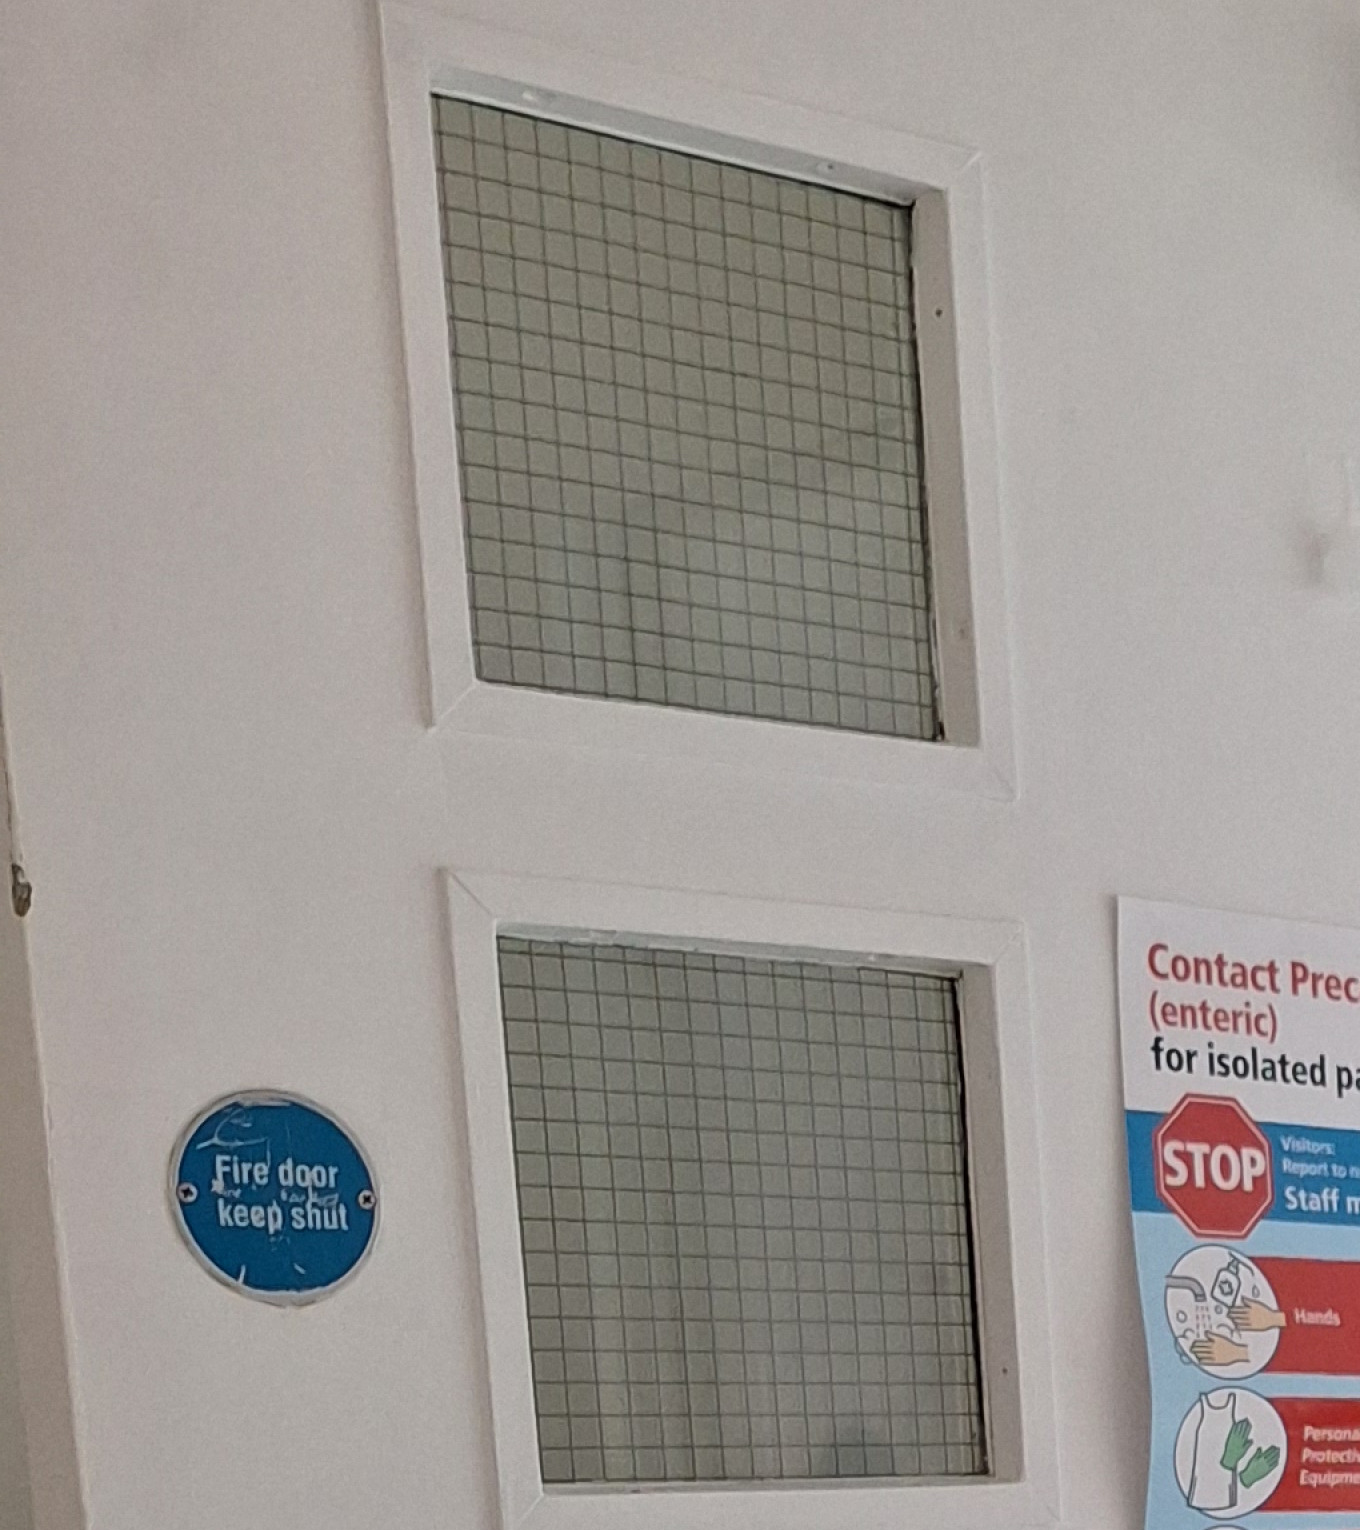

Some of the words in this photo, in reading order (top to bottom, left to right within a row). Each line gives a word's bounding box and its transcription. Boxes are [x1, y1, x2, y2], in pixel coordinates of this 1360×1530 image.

[1148, 943, 1281, 994] Contact
[1150, 990, 1278, 1044] (enteric)
[1151, 1036, 1197, 1074] for
[1207, 1041, 1327, 1088] isolated
[1280, 1135, 1336, 1155] Visitors:
[215, 1154, 269, 1186] Fire
[278, 1158, 339, 1188] door
[1163, 1139, 1266, 1192] STOP
[1282, 1159, 1328, 1179] Report
[1332, 1163, 1347, 1178] to
[217, 1198, 284, 1235] keep
[290, 1199, 349, 1231] shut
[1284, 1185, 1339, 1213] Staff
[1294, 1307, 1341, 1327] Hands
